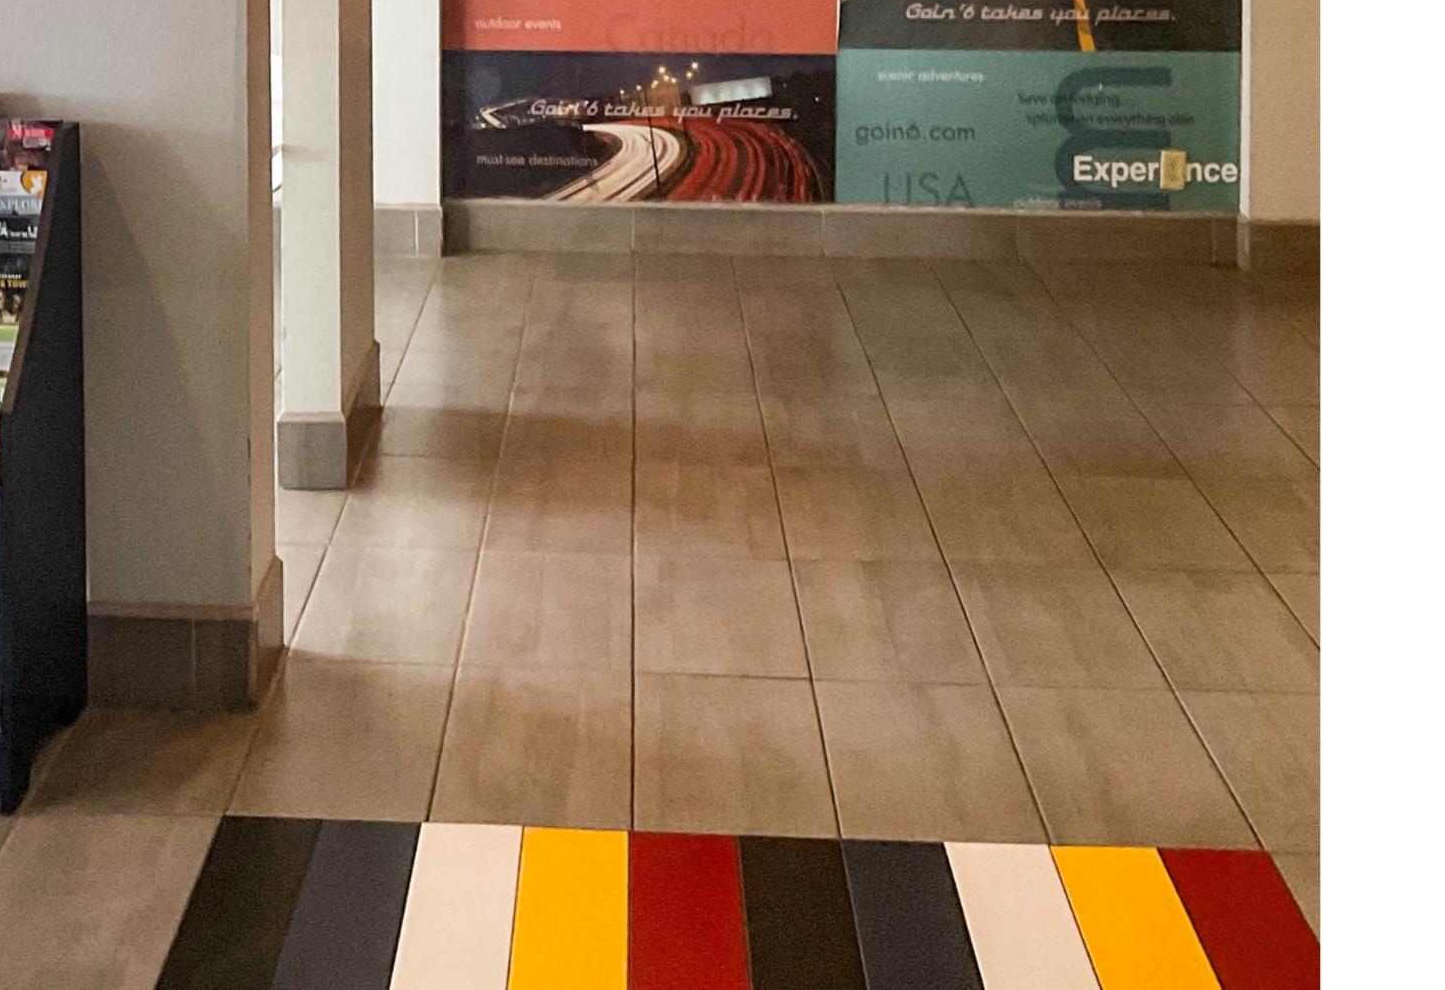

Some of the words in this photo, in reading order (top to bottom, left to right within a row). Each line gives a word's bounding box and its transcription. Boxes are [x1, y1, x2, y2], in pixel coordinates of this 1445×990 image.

[475, 15, 522, 30] outdoor
[525, 17, 561, 30] events
[981, 4, 1043, 20] takes
[1051, 8, 1090, 26] you
[1095, 5, 1176, 26] places.
[917, 68, 985, 82] adventures
[605, 101, 665, 117] takes
[672, 105, 713, 122] you
[717, 103, 798, 123] places.
[855, 121, 976, 145] goin6.com
[529, 153, 597, 167] destinations
[1073, 154, 1238, 188] Expernce
